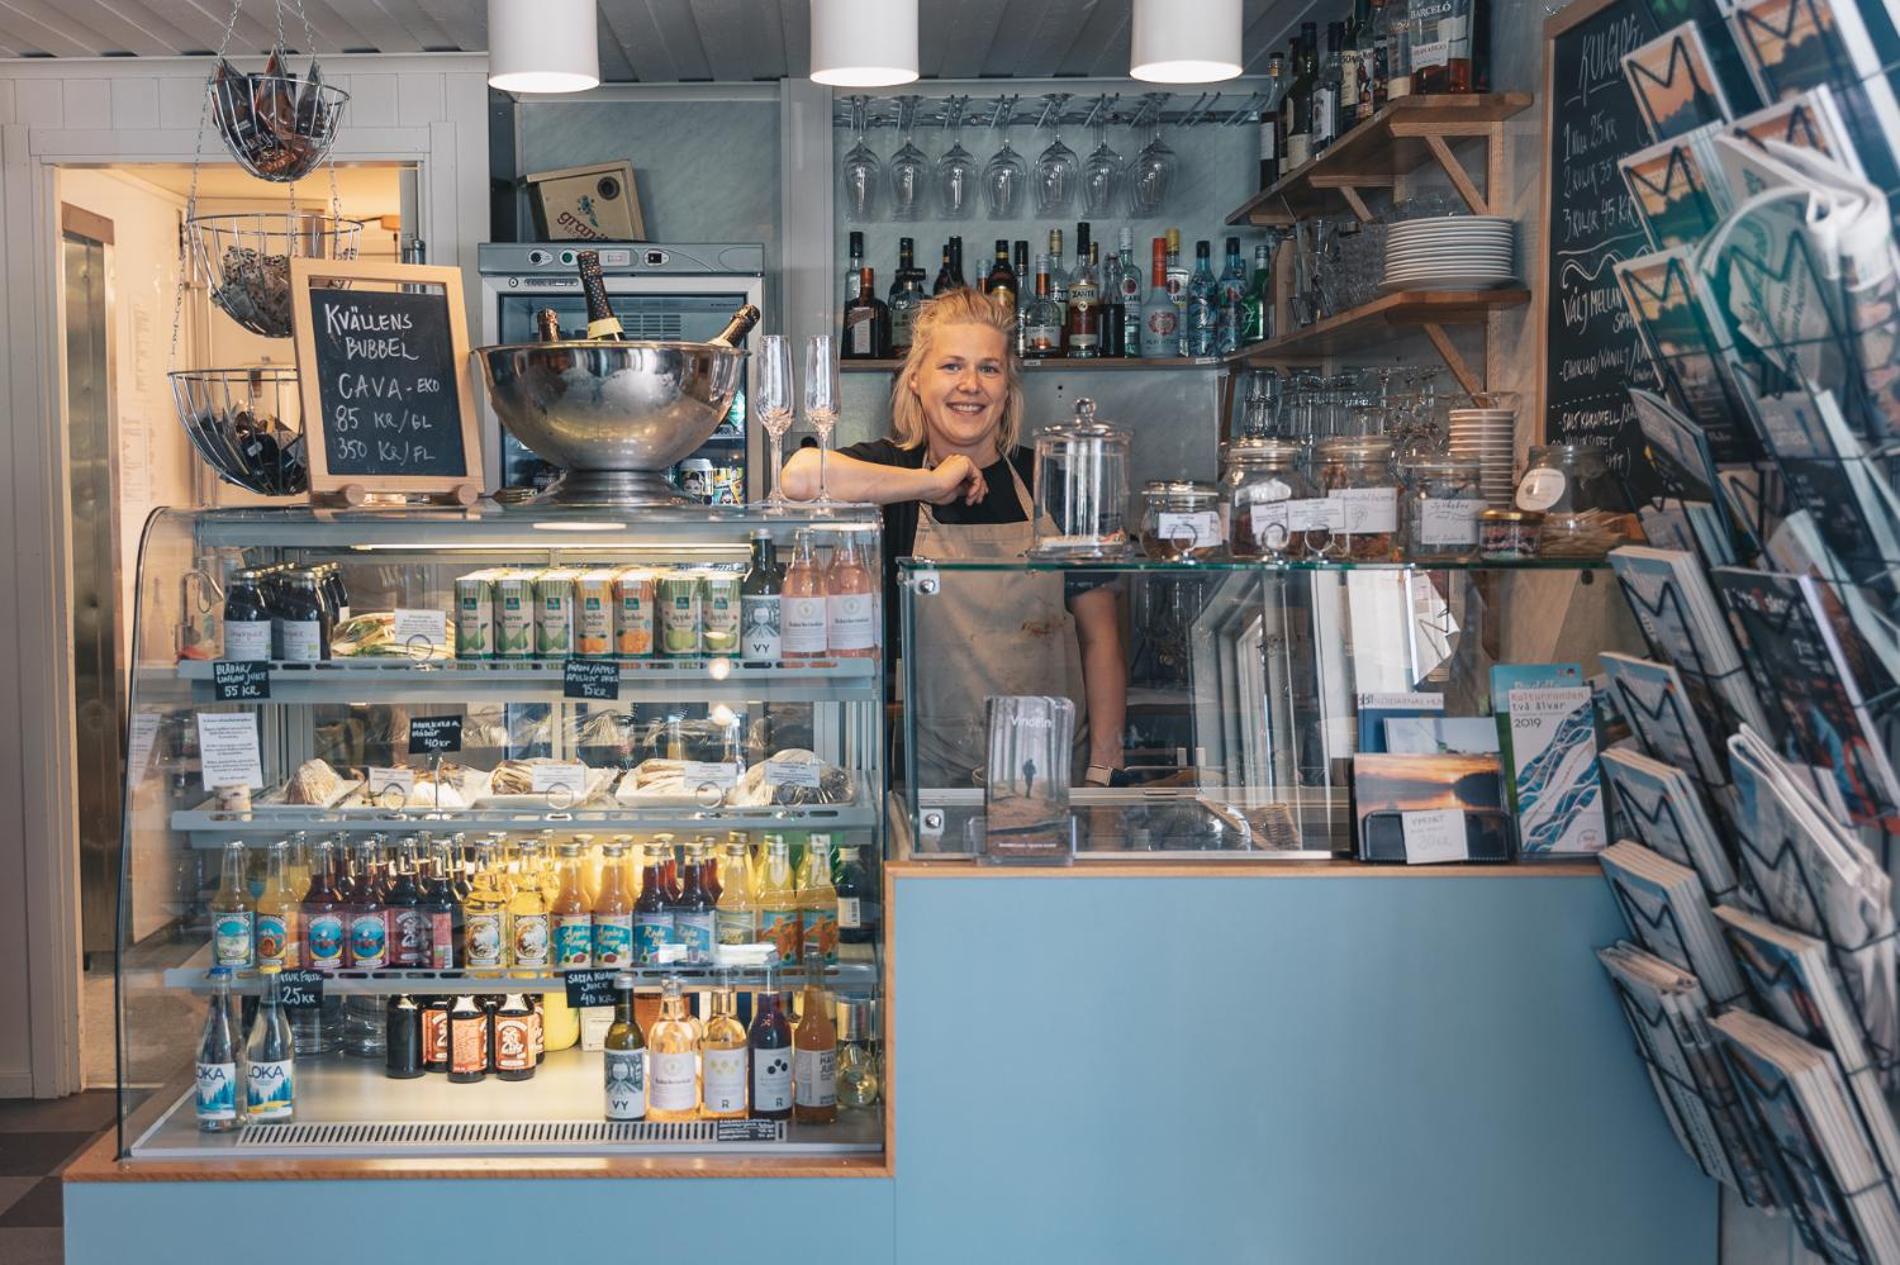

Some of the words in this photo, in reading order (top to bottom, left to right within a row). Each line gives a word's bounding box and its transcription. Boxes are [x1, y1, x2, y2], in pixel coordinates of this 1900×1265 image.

[324, 303, 413, 336] KVÄLLENS
[345, 336, 420, 361] BUBBEL
[338, 372, 403, 402] CAVA
[417, 377, 441, 394] EKO
[335, 404, 361, 433] 85
[337, 436, 369, 461] 350
[753, 644, 770, 654] VY
[224, 685, 239, 698] 55
[241, 685, 262, 697] KR
[1512, 701, 1531, 712] två
[1535, 701, 1567, 711] älvar
[1513, 718, 1542, 729] 2019
[612, 1099, 629, 1111] VY
